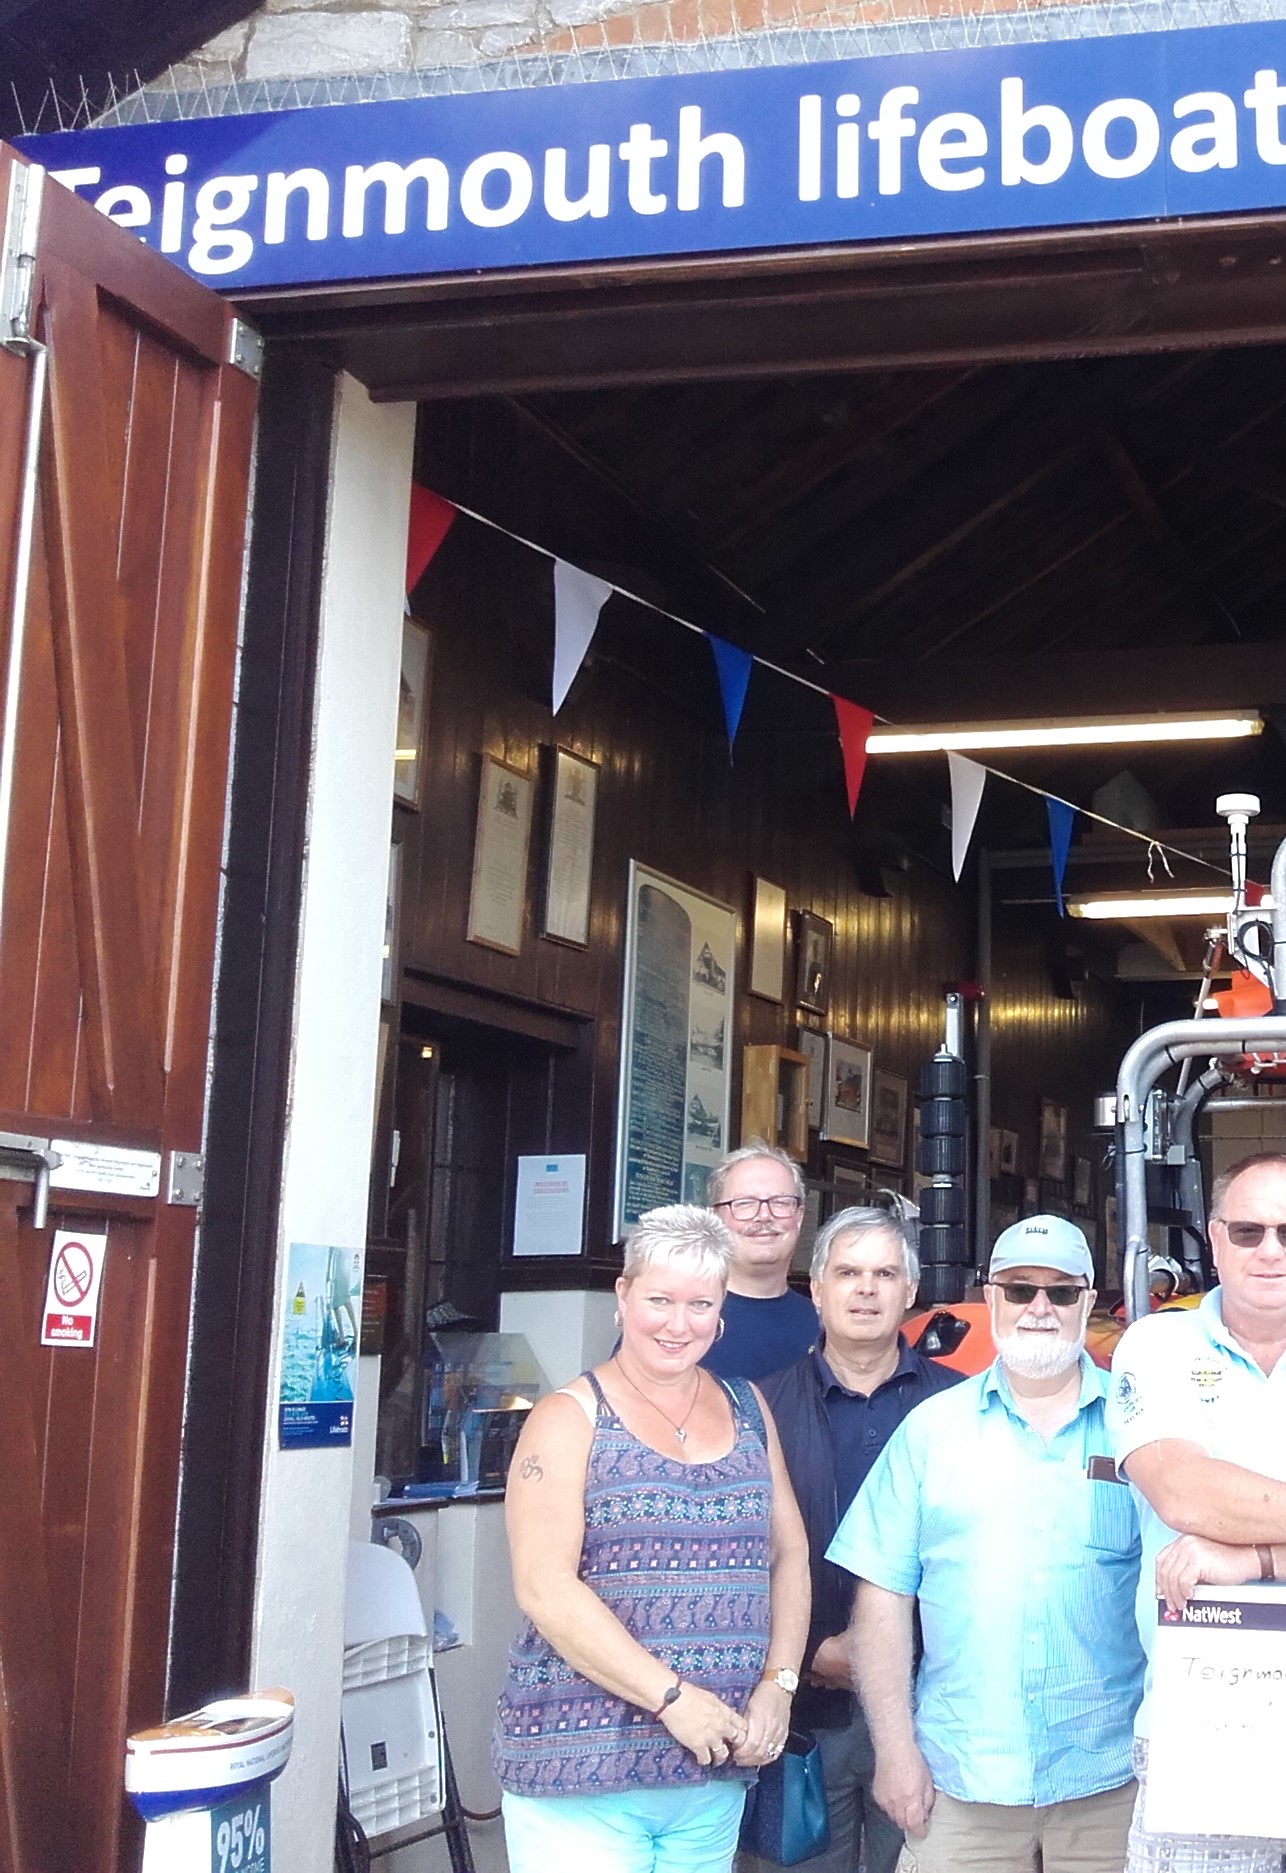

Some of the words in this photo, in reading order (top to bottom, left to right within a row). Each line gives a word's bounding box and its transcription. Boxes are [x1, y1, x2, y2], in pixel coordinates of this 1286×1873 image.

[61, 1314, 74, 1326] No
[51, 1327, 83, 1340] smoking
[1182, 1606, 1242, 1625] NatWest
[217, 1804, 265, 1873] 95%
